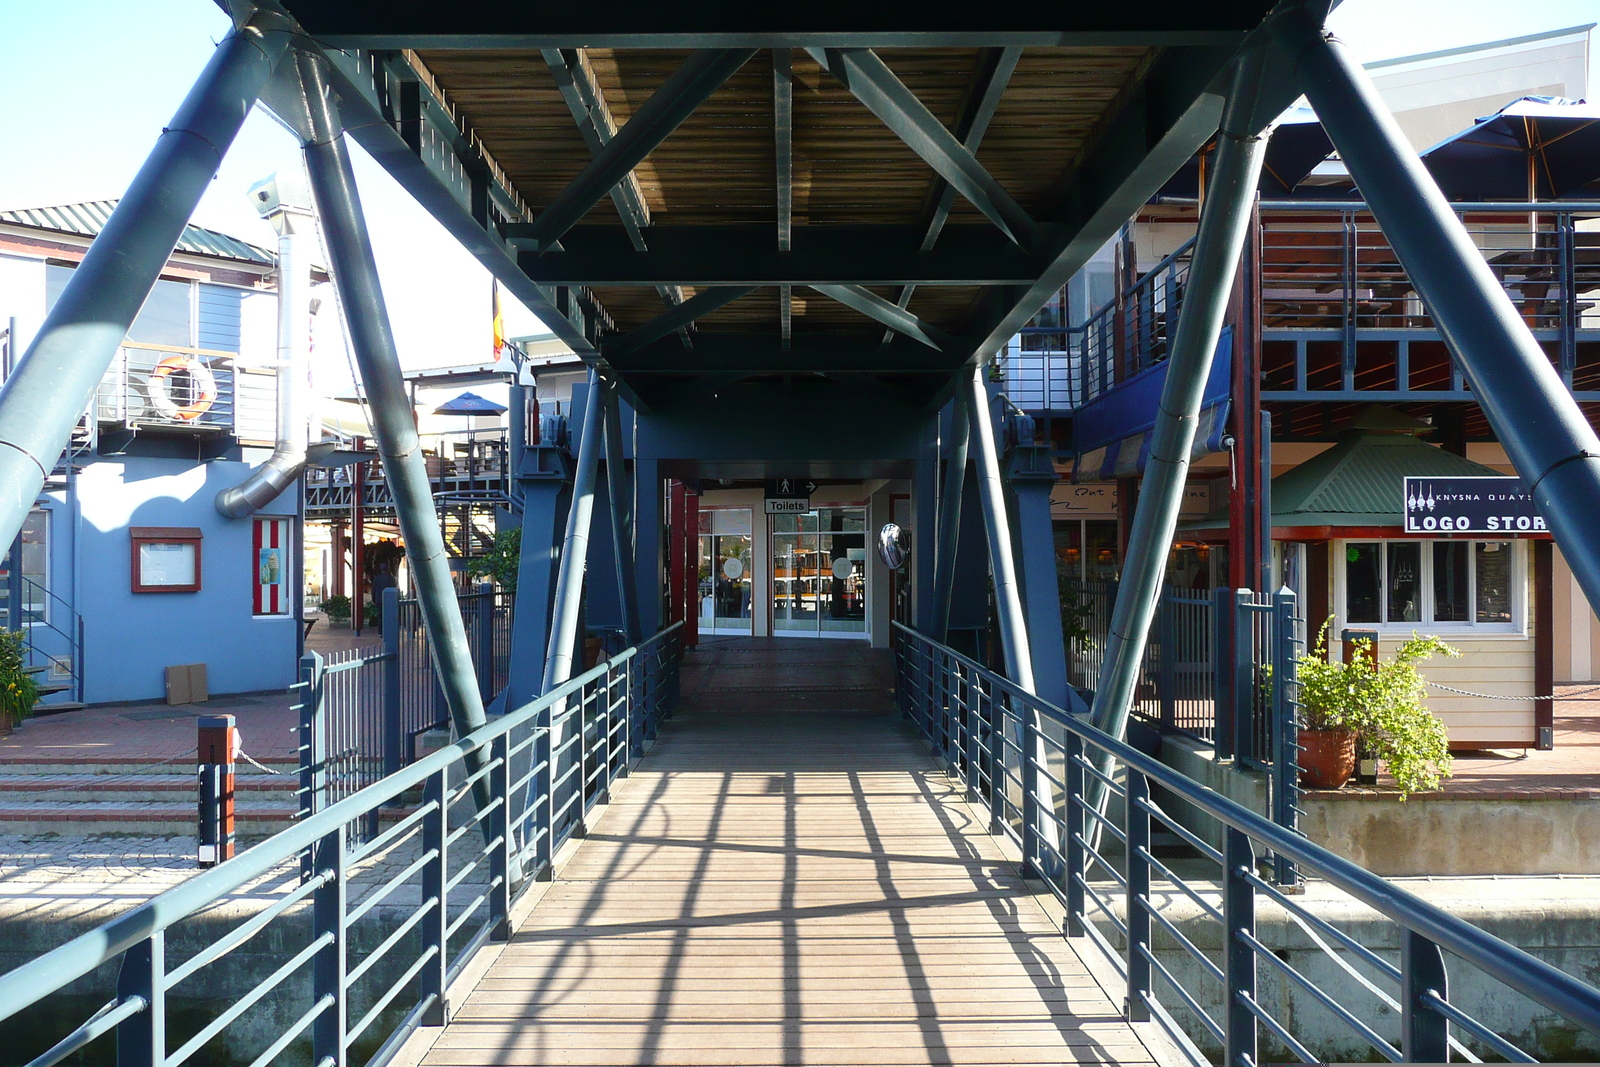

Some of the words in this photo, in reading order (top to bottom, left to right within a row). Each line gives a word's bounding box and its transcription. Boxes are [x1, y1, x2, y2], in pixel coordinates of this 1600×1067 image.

[770, 501, 805, 511] Toilets
[1409, 516, 1470, 530] LOGO
[1487, 516, 1547, 530] STOR
